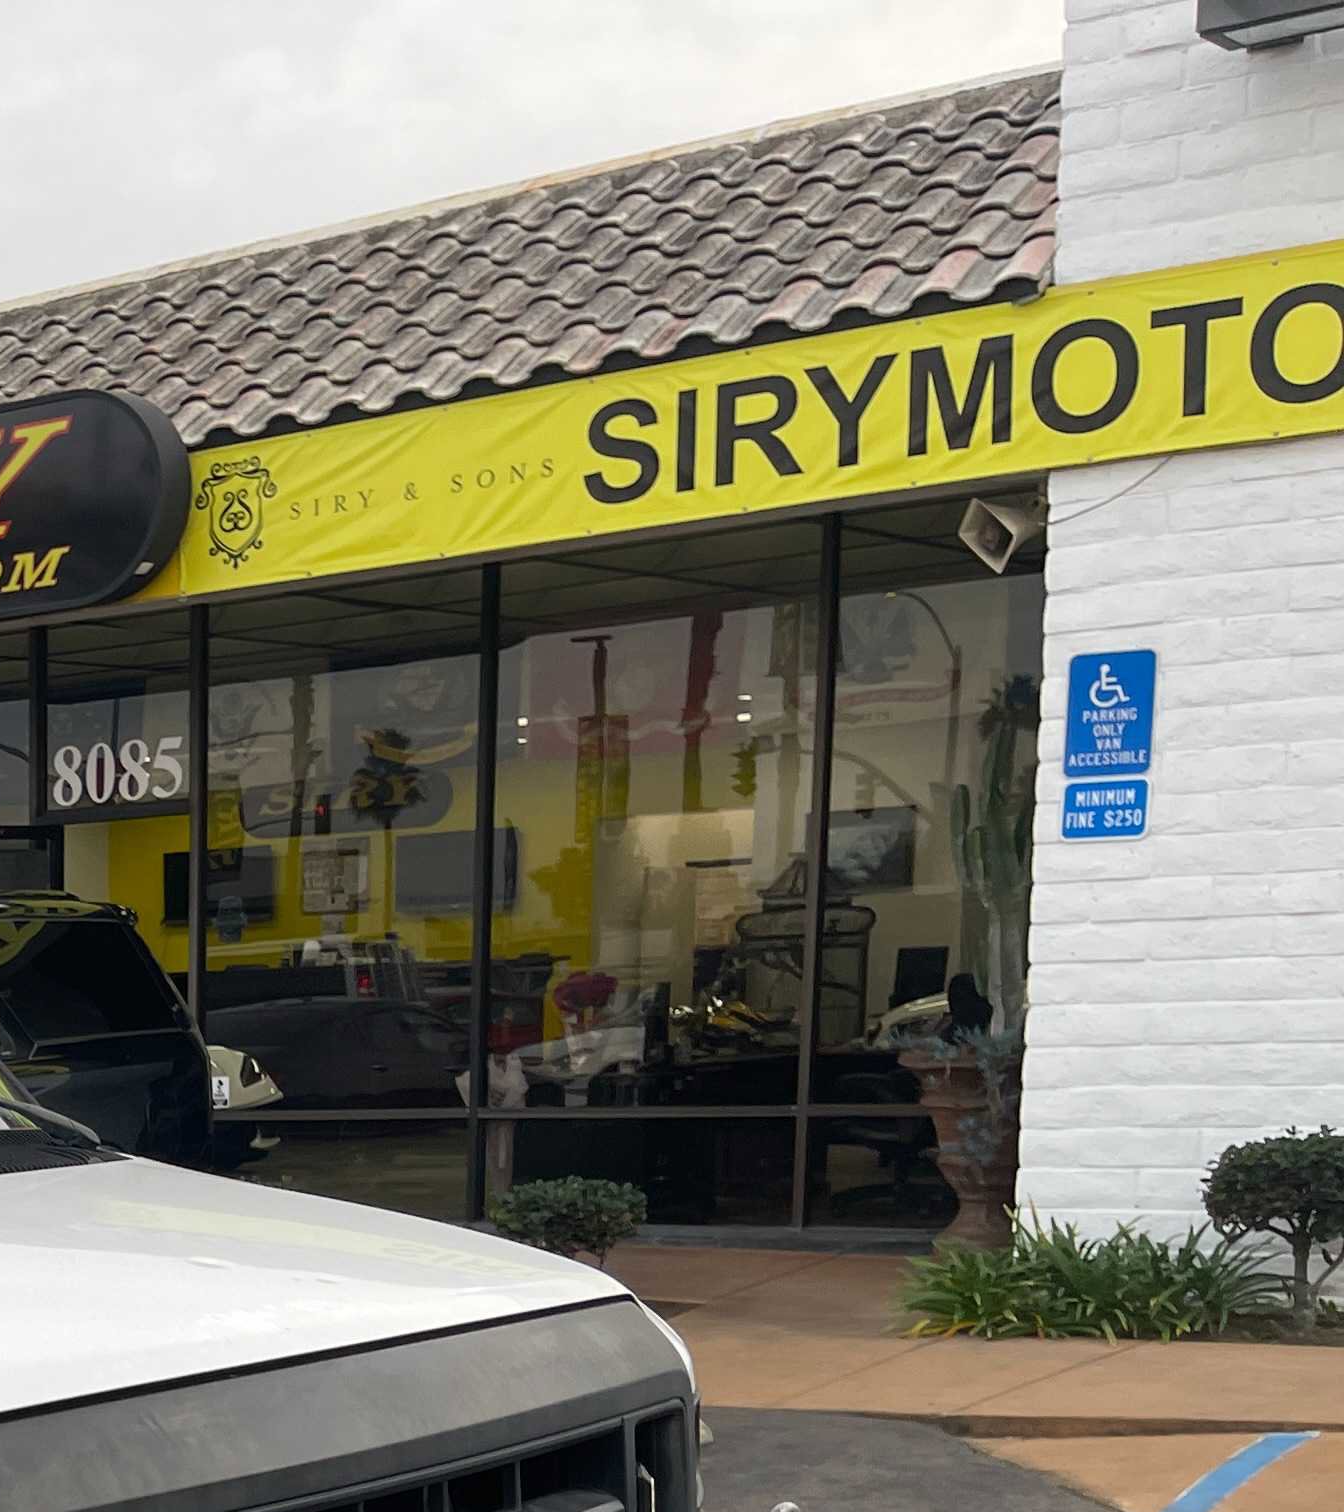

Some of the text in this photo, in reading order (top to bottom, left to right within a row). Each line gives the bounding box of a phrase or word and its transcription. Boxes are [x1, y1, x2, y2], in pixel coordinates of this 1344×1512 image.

[583, 282, 1344, 504] SIRYMOTO
[289, 458, 555, 520] SIRY & SONS
[1082, 707, 1138, 724] PARKING
[1092, 723, 1126, 737] ONLY
[1095, 737, 1123, 750] VAN
[1068, 750, 1147, 767] ACCESSIBLE
[52, 736, 184, 807] 8085
[1075, 788, 1136, 807] MINIMUM
[1065, 808, 1144, 830] FINE $250
